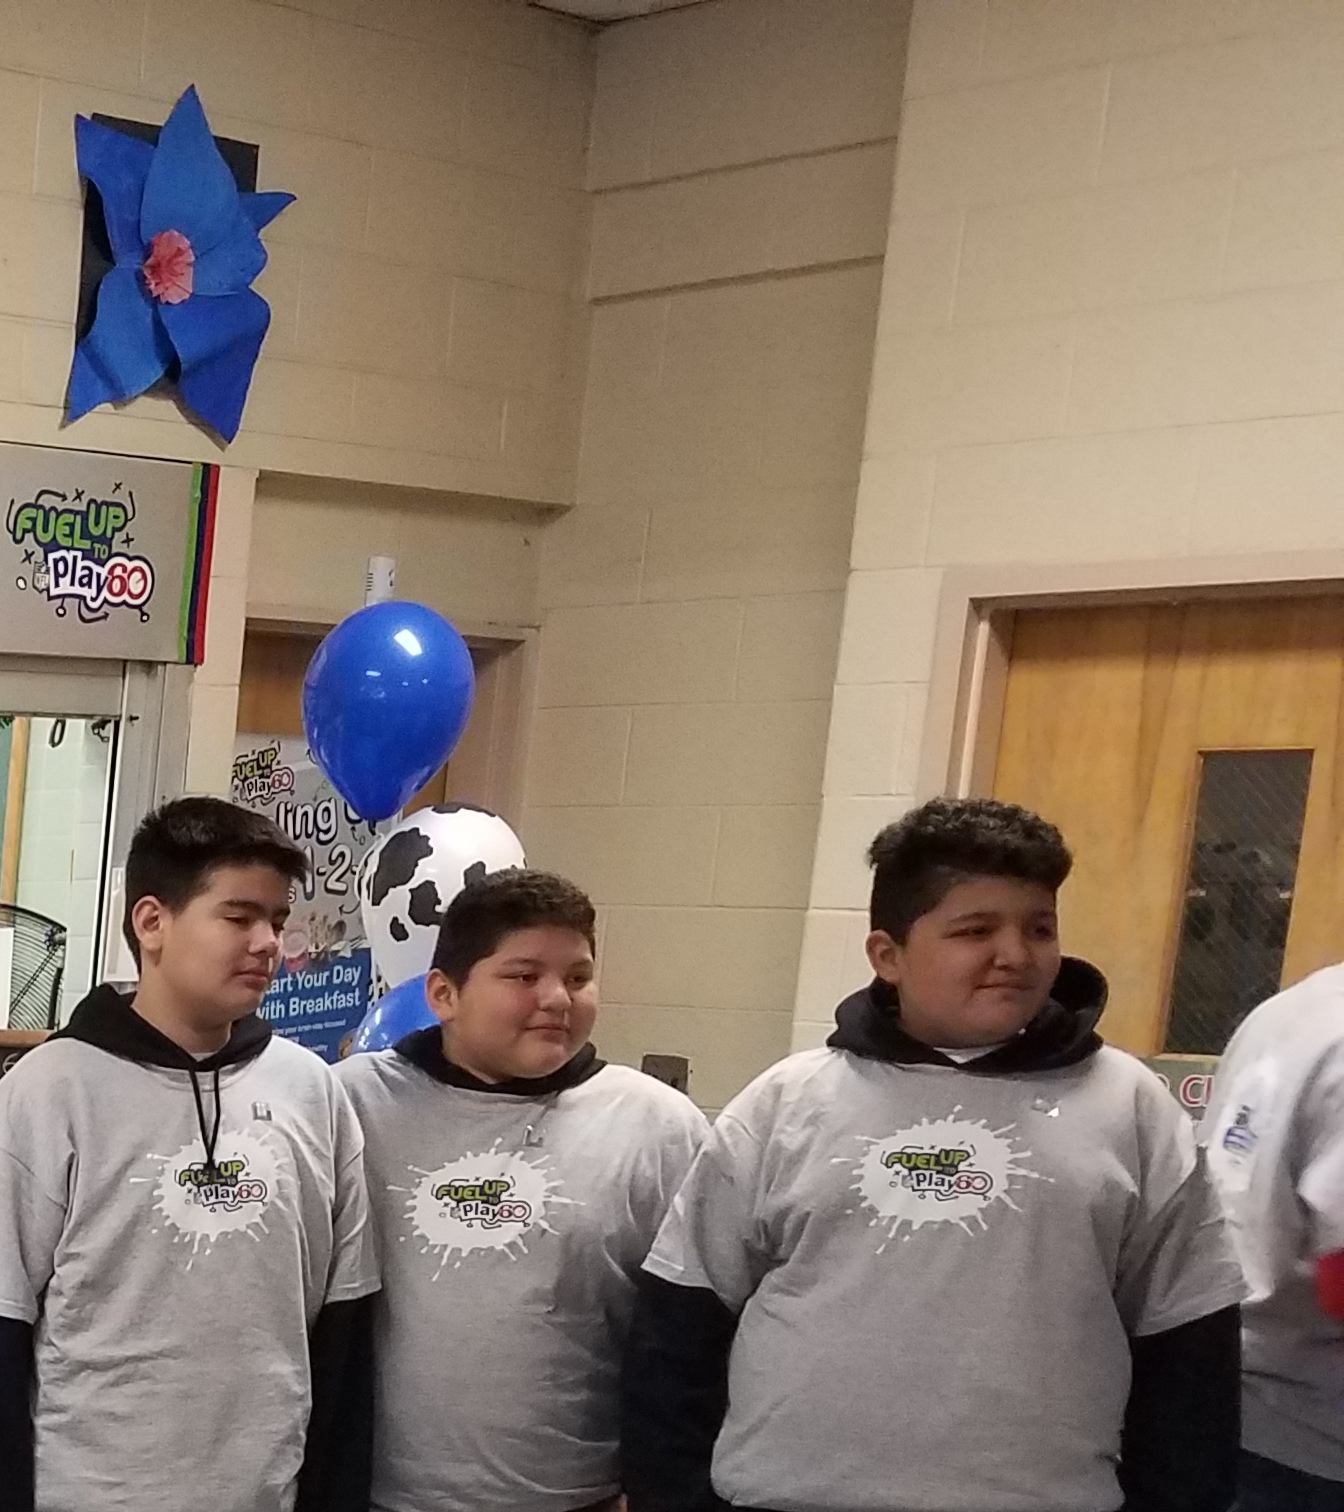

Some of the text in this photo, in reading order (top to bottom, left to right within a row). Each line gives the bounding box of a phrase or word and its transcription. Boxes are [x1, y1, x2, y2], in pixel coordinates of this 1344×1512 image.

[15, 503, 126, 549] FUEL UP
[93, 543, 109, 559] TO
[258, 750, 277, 767] UP
[265, 964, 362, 995] art Your Day
[288, 987, 361, 1017] Breakfast
[220, 1162, 244, 1177] UP
[887, 1150, 970, 1170] FUEL UP
[437, 1181, 509, 1200] FUEL UP
